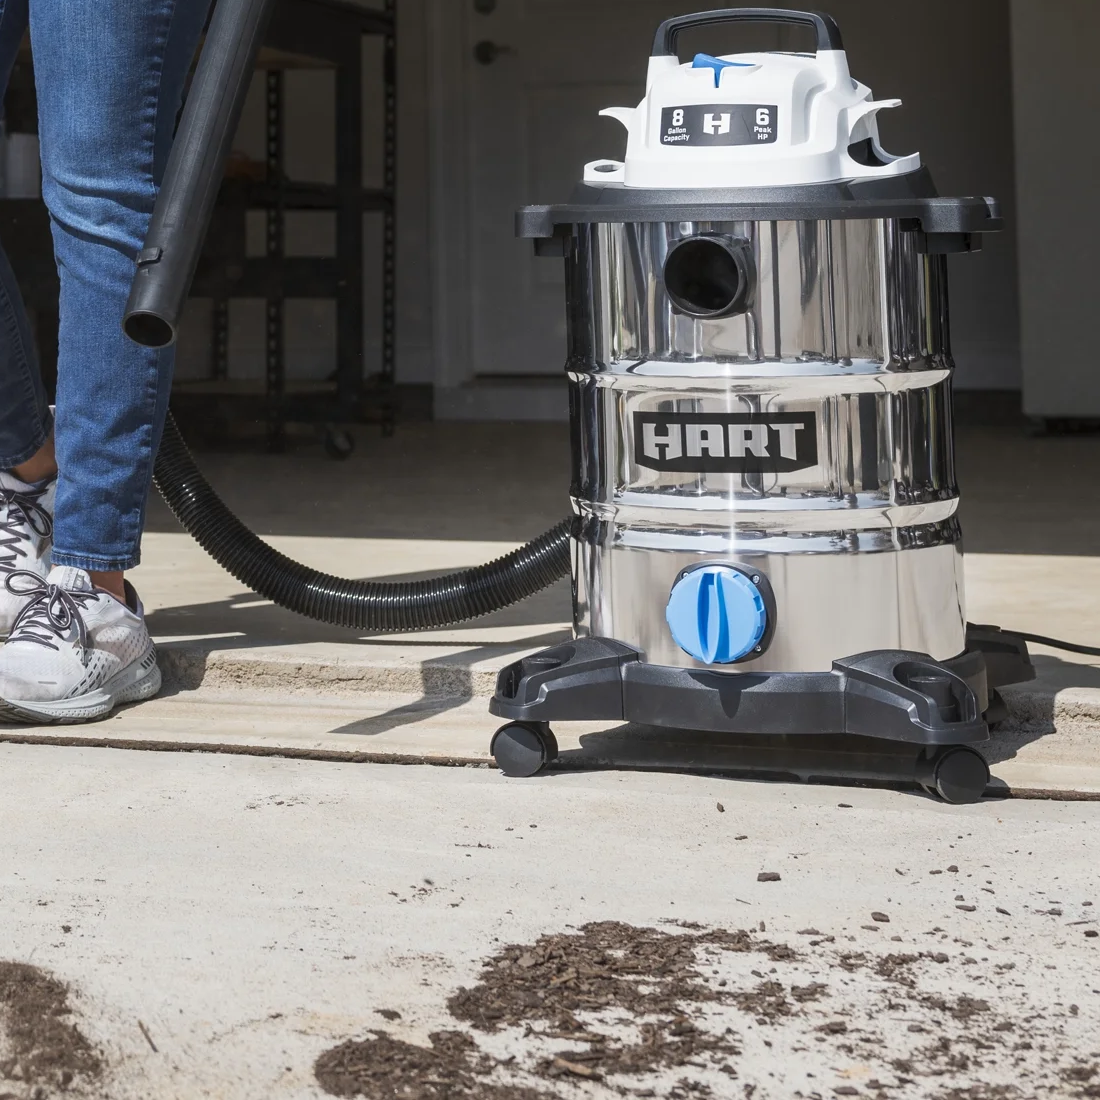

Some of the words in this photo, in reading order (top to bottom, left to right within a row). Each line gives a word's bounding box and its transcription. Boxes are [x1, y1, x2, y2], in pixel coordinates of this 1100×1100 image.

[672, 109, 684, 126] 8
[703, 113, 731, 135] H
[756, 108, 769, 125] 6
[663, 134, 690, 142] Capacity
[642, 423, 805, 461] HART
